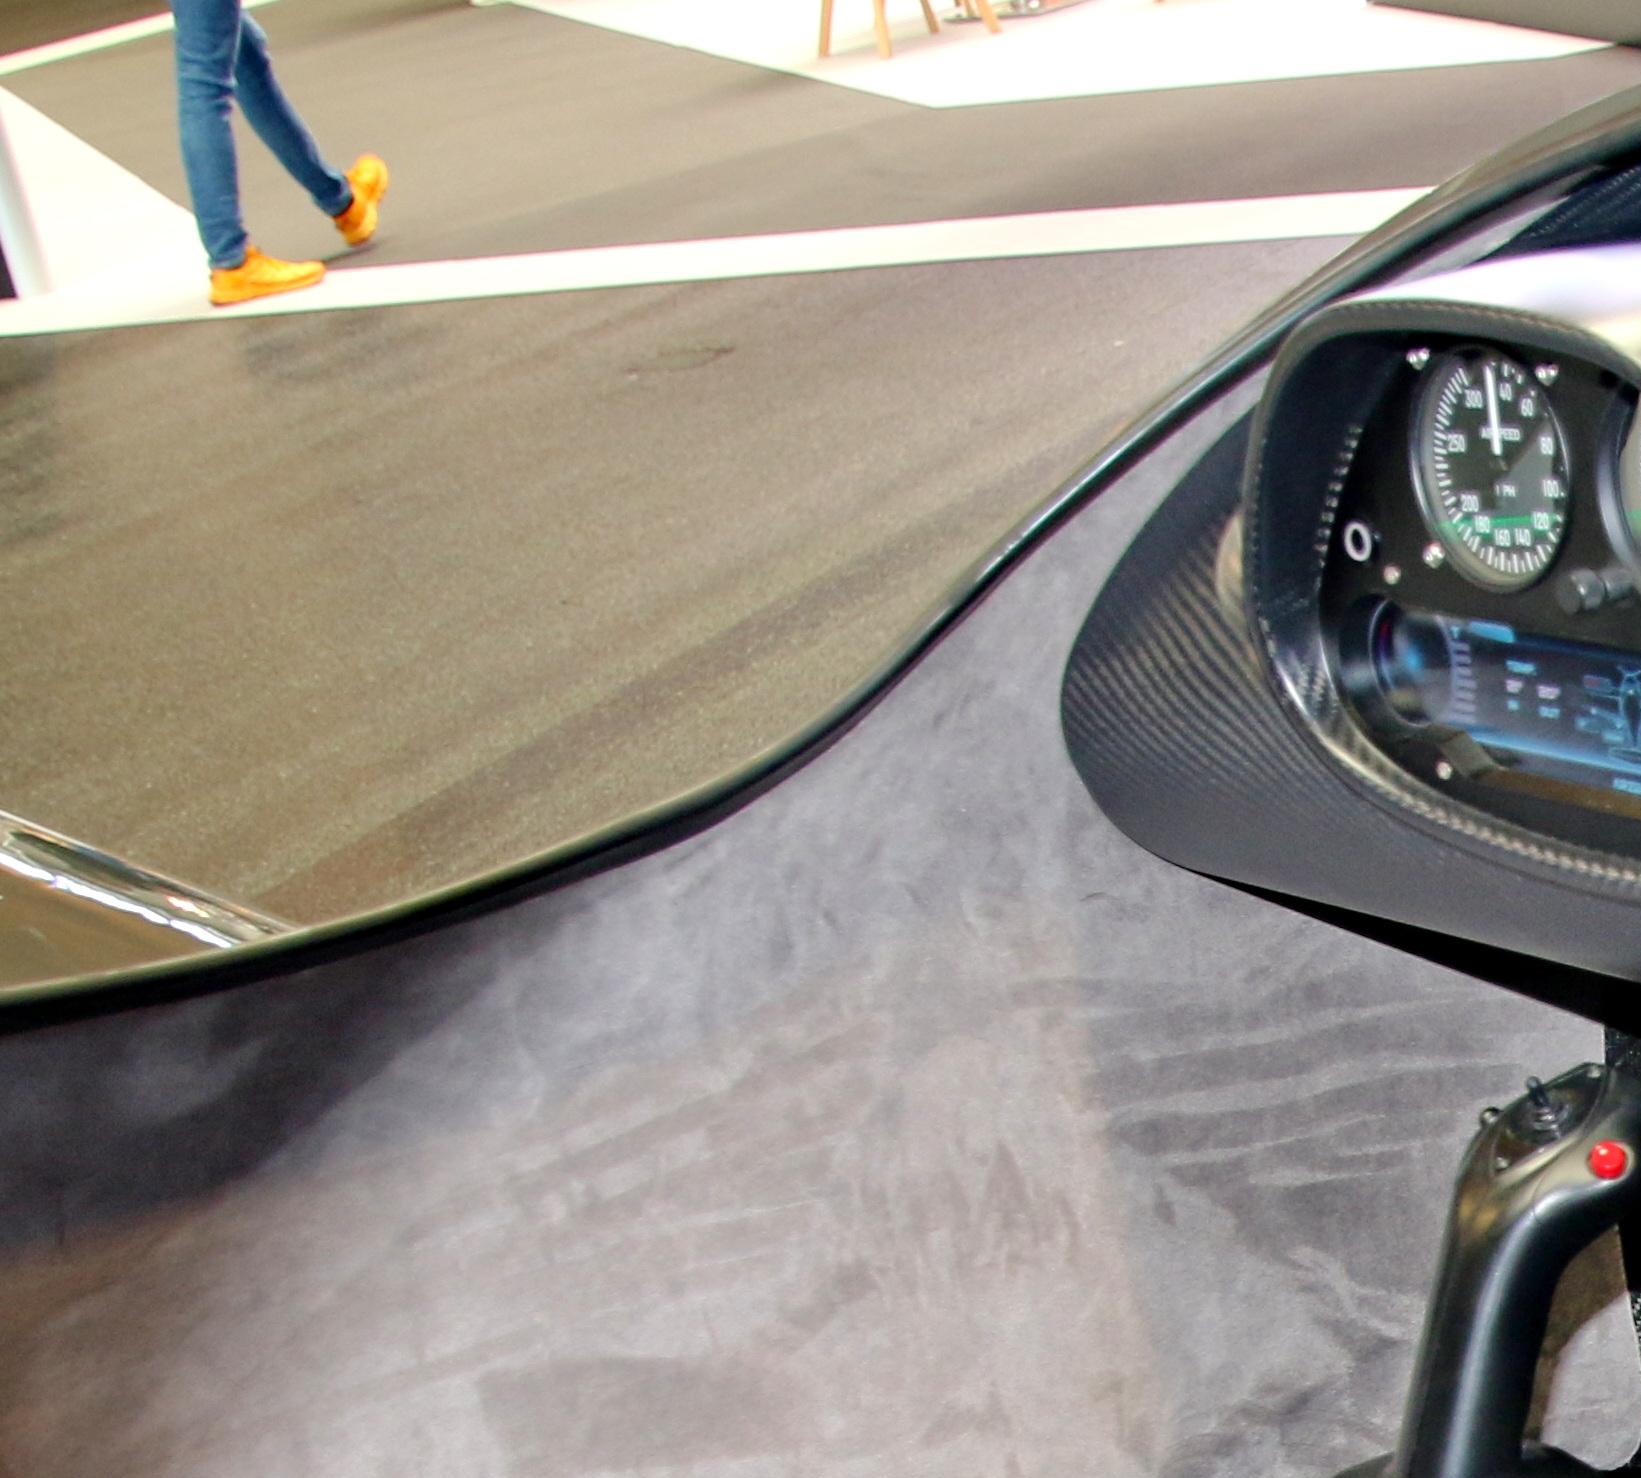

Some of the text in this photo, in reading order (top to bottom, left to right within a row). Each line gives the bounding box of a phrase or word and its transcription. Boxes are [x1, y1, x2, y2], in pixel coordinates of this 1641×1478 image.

[1464, 388, 1483, 409] 300
[1499, 383, 1512, 401] 40
[1520, 398, 1534, 417] 60
[1448, 434, 1466, 453] 250
[1480, 428, 1521, 442] AIPEED
[1540, 436, 1553, 455] 80
[1542, 479, 1559, 498] 100
[1460, 494, 1479, 513] 200
[1474, 516, 1490, 534] 180
[1532, 512, 1550, 530] 120
[1494, 529, 1511, 547] 160
[1514, 528, 1531, 547] 140
